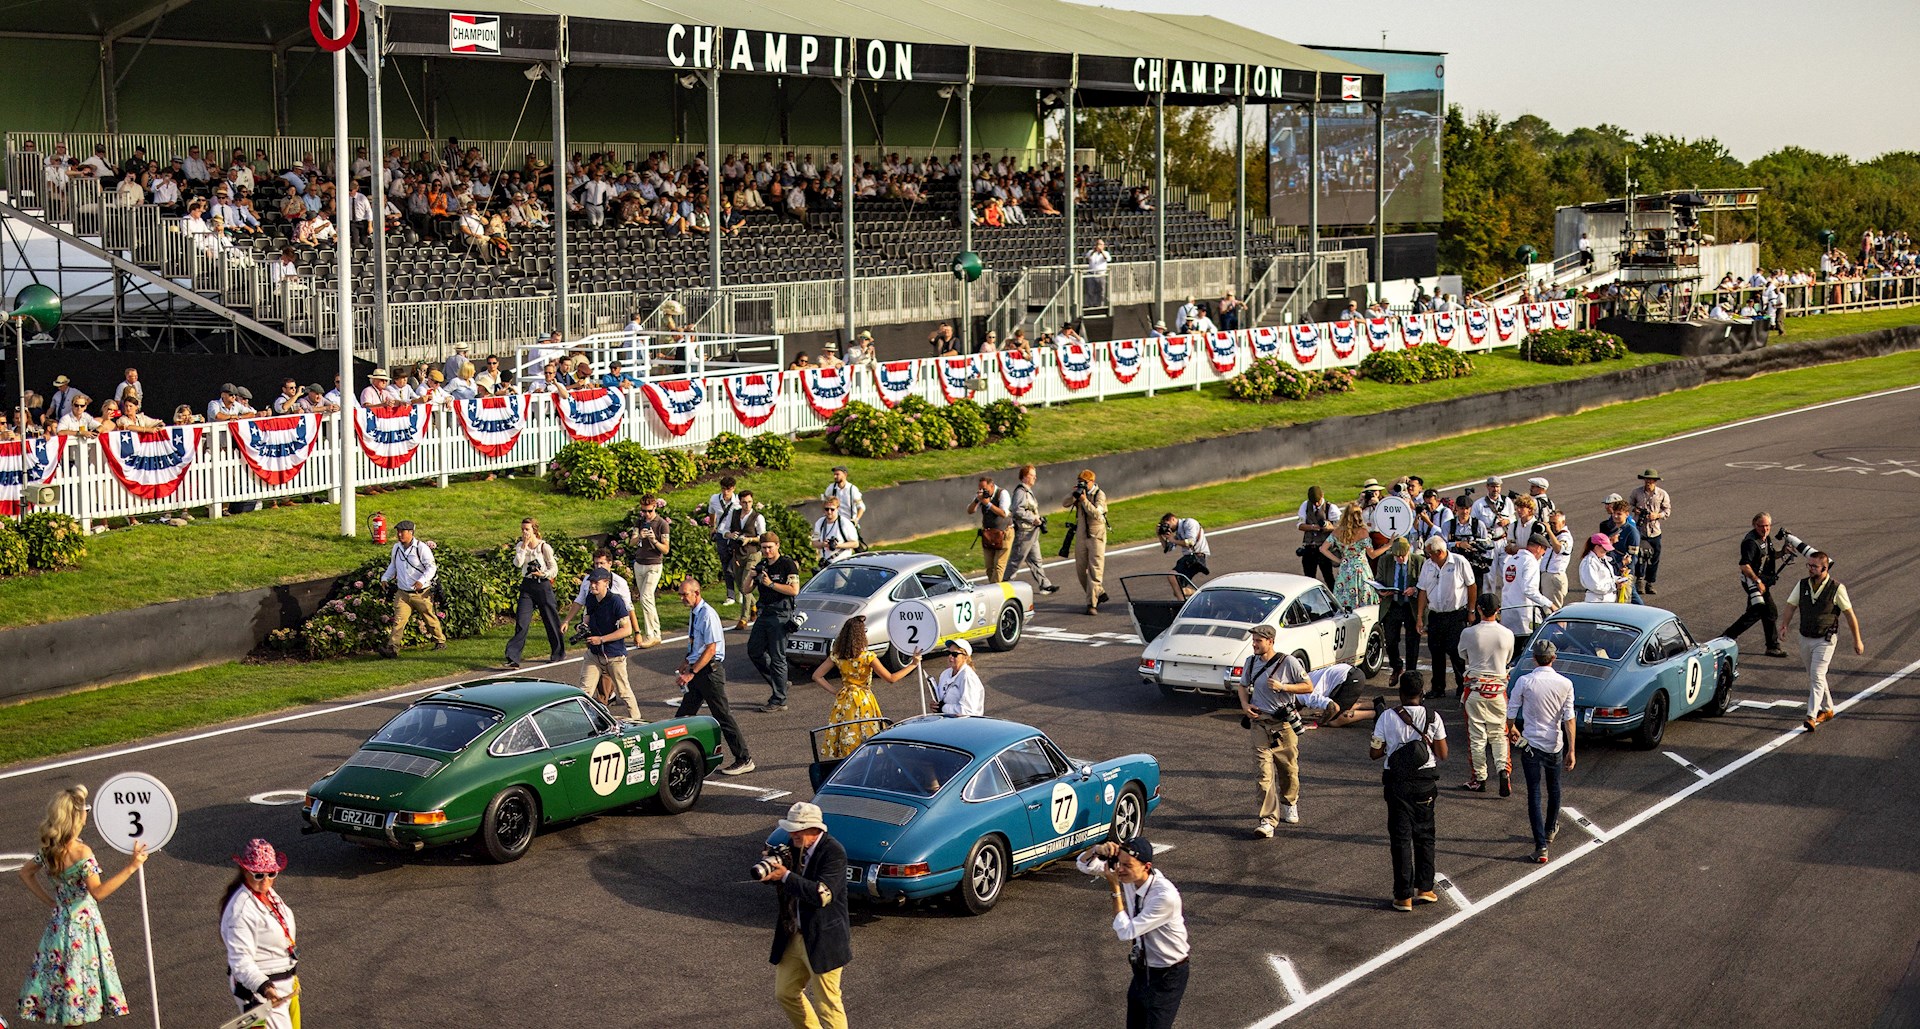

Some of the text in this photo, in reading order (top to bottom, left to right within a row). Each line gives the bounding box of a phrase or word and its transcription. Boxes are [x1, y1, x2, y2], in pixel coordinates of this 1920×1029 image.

[452, 27, 496, 42] CHAMPION
[666, 23, 913, 81] CHAMPION
[1133, 57, 1283, 98] CHAMPION
[1383, 505, 1402, 514] ROW
[1389, 516, 1397, 531] 1
[899, 611, 925, 621] ROW
[956, 601, 972, 624] 73
[791, 640, 815, 651] 3 SWB
[907, 625, 920, 644] 2
[1333, 625, 1346, 651] 99
[1688, 662, 1699, 699] 9
[593, 752, 621, 786] 777
[114, 791, 151, 805] ROW
[1055, 794, 1073, 824] 77
[128, 811, 144, 838] 3
[341, 809, 377, 827] GRZ 141
[1045, 831, 1088, 854] FRANKLIN & SONS
